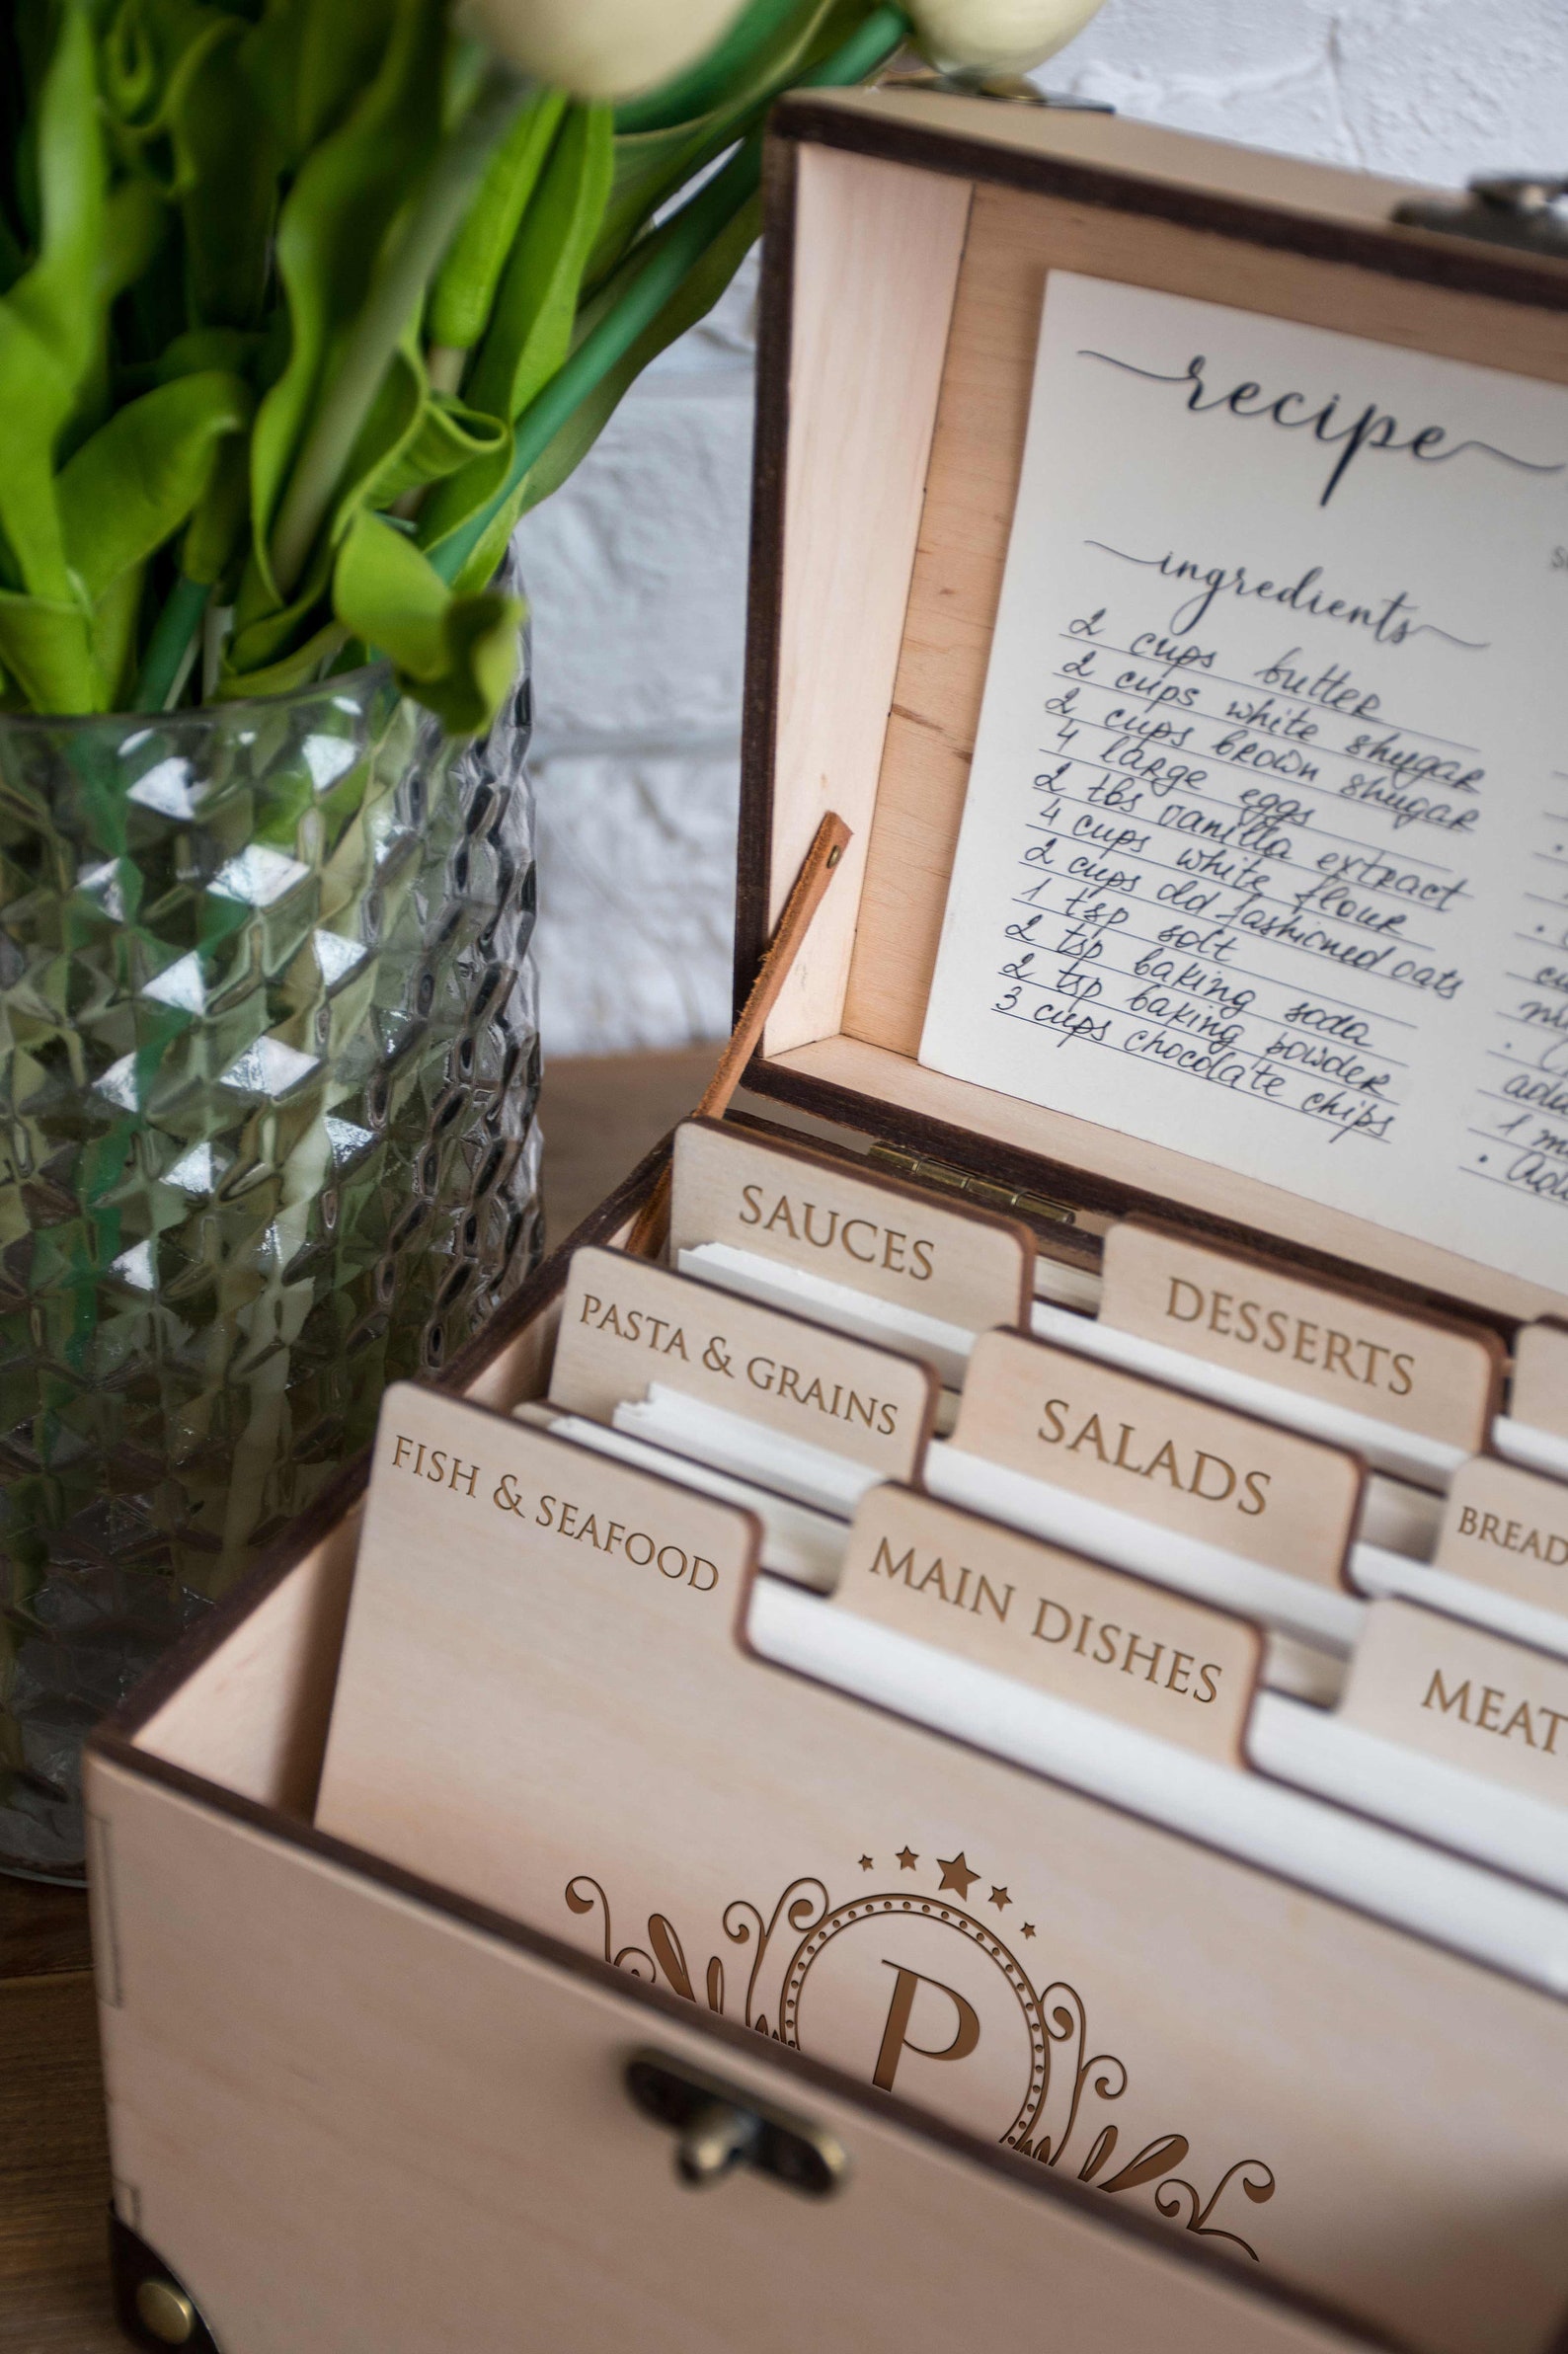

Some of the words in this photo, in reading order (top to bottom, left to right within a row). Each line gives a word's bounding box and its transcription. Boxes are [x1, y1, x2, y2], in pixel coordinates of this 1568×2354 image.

[1076, 350, 1566, 508] recipe
[1068, 608, 1107, 636] 2
[1130, 632, 1217, 677] cups
[1083, 539, 1491, 648] ingredients
[1045, 687, 1080, 714] 2
[1104, 708, 1195, 749] cups
[1062, 650, 1096, 676] 2
[1115, 670, 1201, 713] cups
[1225, 698, 1319, 742] white
[1057, 718, 1079, 752] 4
[1100, 735, 1208, 797] large
[1238, 789, 1315, 829] eggs
[1034, 761, 1072, 792] 2
[1087, 773, 1143, 813] tbs
[1158, 804, 1292, 859] vanilla
[1315, 849, 1474, 913] extract
[1040, 798, 1061, 825] 4
[1071, 815, 1151, 859] cups
[1177, 847, 1271, 895] white
[1021, 877, 1052, 902] 1
[1065, 888, 1130, 939] tsp
[1024, 837, 1058, 864] 2
[1067, 856, 1141, 899] cups
[1157, 880, 1221, 915] old
[1390, 959, 1464, 1000] oats
[1002, 953, 1037, 979] 2
[1057, 962, 1102, 1012] tsp
[1127, 984, 1245, 1055] baking
[1004, 914, 1043, 942] 2
[1057, 922, 1103, 967] tsp
[1134, 948, 1256, 1019] baking
[1284, 1002, 1372, 1047] soda
[996, 986, 1022, 1011] 3
[1034, 1004, 1112, 1048] cups
[1124, 1030, 1286, 1097] chocolate
[1301, 1091, 1395, 1143] chips
[739, 1184, 935, 1281] SAUCES
[580, 1293, 690, 1362] PASTA
[702, 1335, 737, 1378] &
[745, 1356, 899, 1435] GRAINS
[1165, 1276, 1417, 1396] DESSERTS
[392, 1435, 481, 1499] FISH
[493, 1473, 526, 1521] &
[535, 1494, 720, 1593] SEAFOOD
[1037, 1398, 1273, 1516] SALADS
[869, 1536, 1017, 1624] MAIN
[1030, 1597, 1224, 1704] DISHES
[871, 1958, 981, 2093] P
